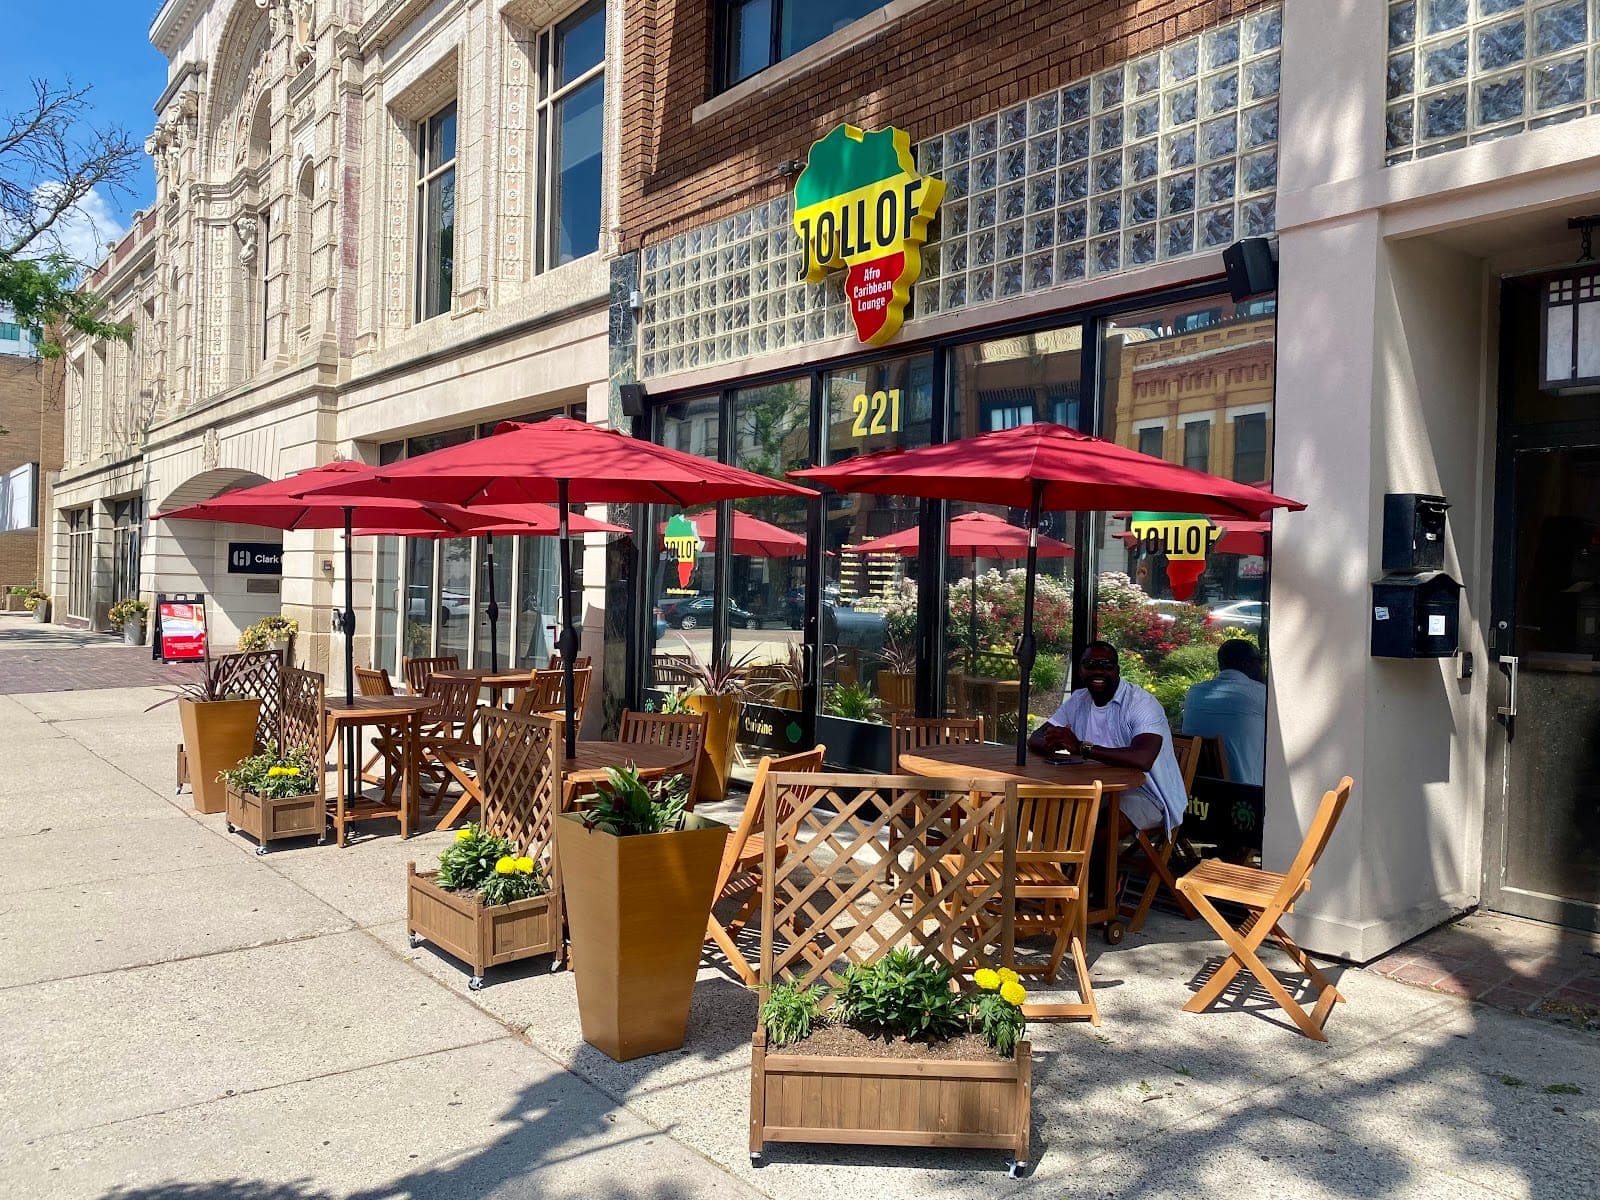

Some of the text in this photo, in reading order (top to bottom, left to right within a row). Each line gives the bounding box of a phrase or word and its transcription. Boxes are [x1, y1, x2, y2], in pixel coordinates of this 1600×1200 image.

[798, 180, 922, 281] JOLLOF
[863, 267, 881, 281] Afro
[853, 280, 892, 298] Caribbean
[857, 296, 886, 312] Lounge
[852, 389, 900, 437] 221
[666, 540, 698, 560] JOLLOF
[1134, 525, 1217, 559] JOLLOF
[254, 554, 279, 564] Clark
